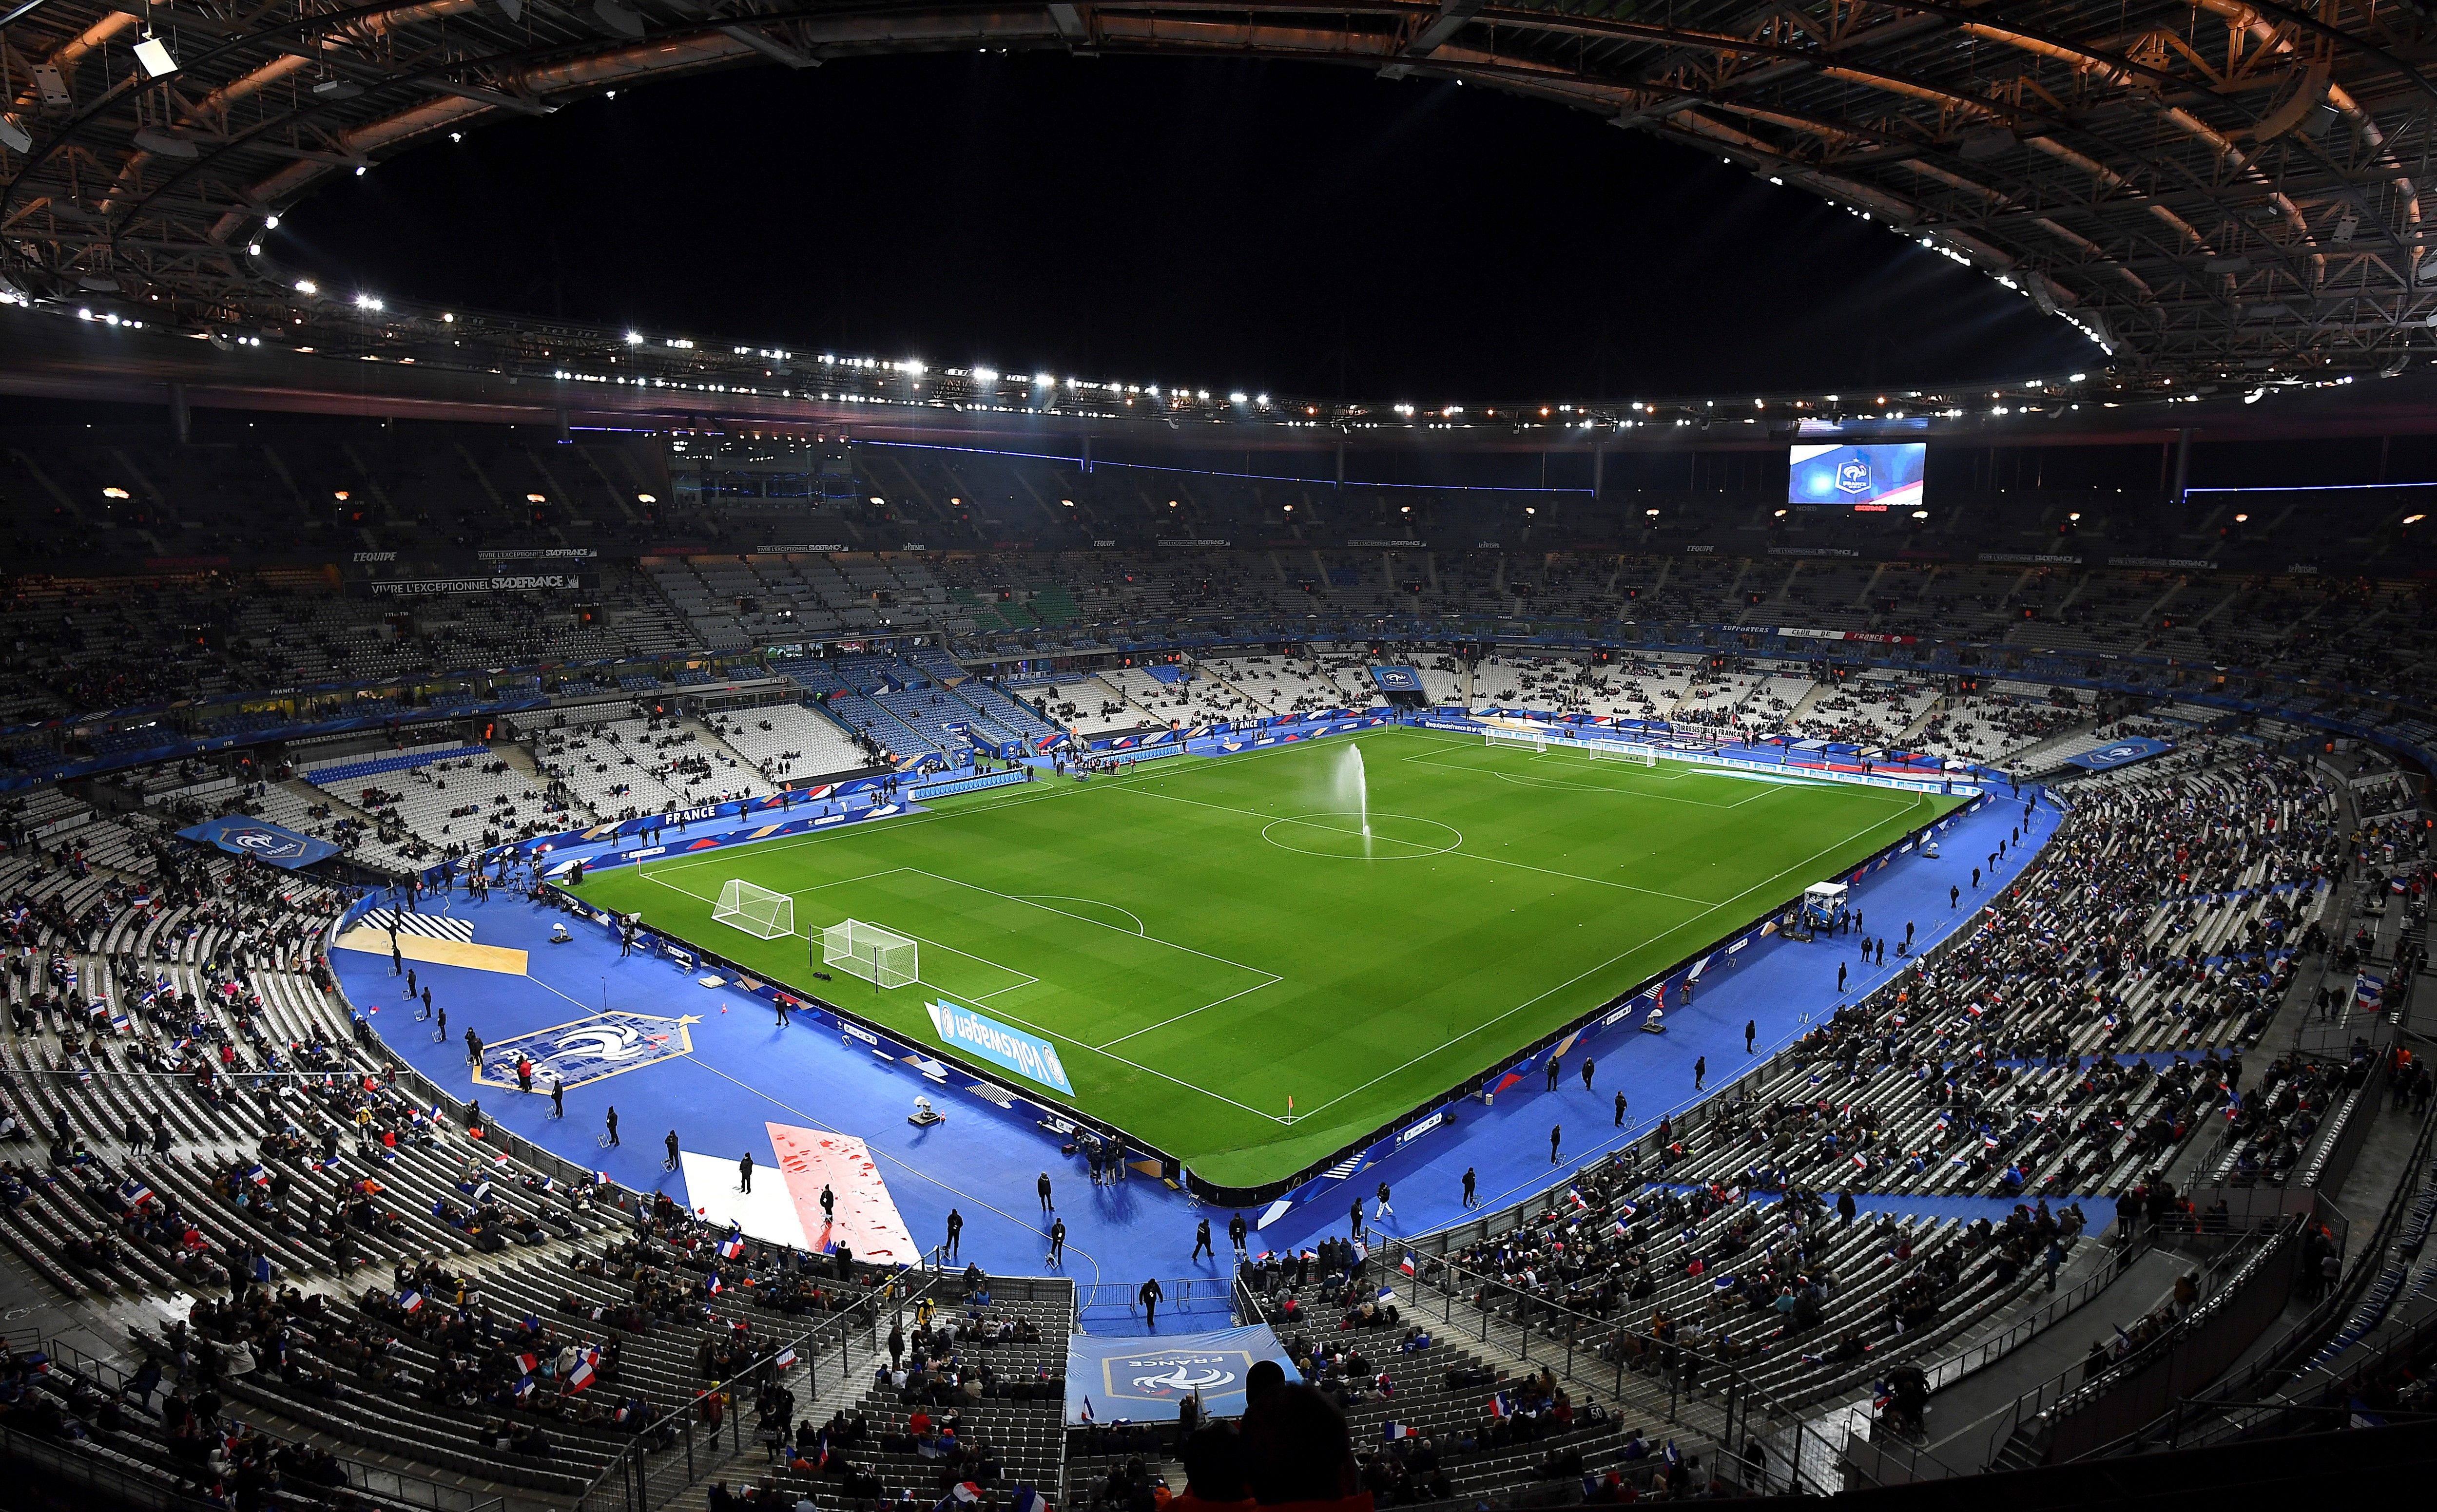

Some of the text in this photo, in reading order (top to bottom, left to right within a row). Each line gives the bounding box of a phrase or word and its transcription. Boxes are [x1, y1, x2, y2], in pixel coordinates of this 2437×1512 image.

[353, 552, 397, 562] L'EQUIPE
[371, 575, 563, 594] VIVRE L'EXCEPTIONNEL STADEFRANCE
[1854, 633, 1885, 641] FRANCE
[271, 687, 295, 695] FRANCE
[1425, 721, 1466, 732] @equipedefrance
[665, 805, 716, 825] FRANCE
[955, 1014, 1052, 1083] Volkswagen
[1128, 1356, 1224, 1366] FRANCE
